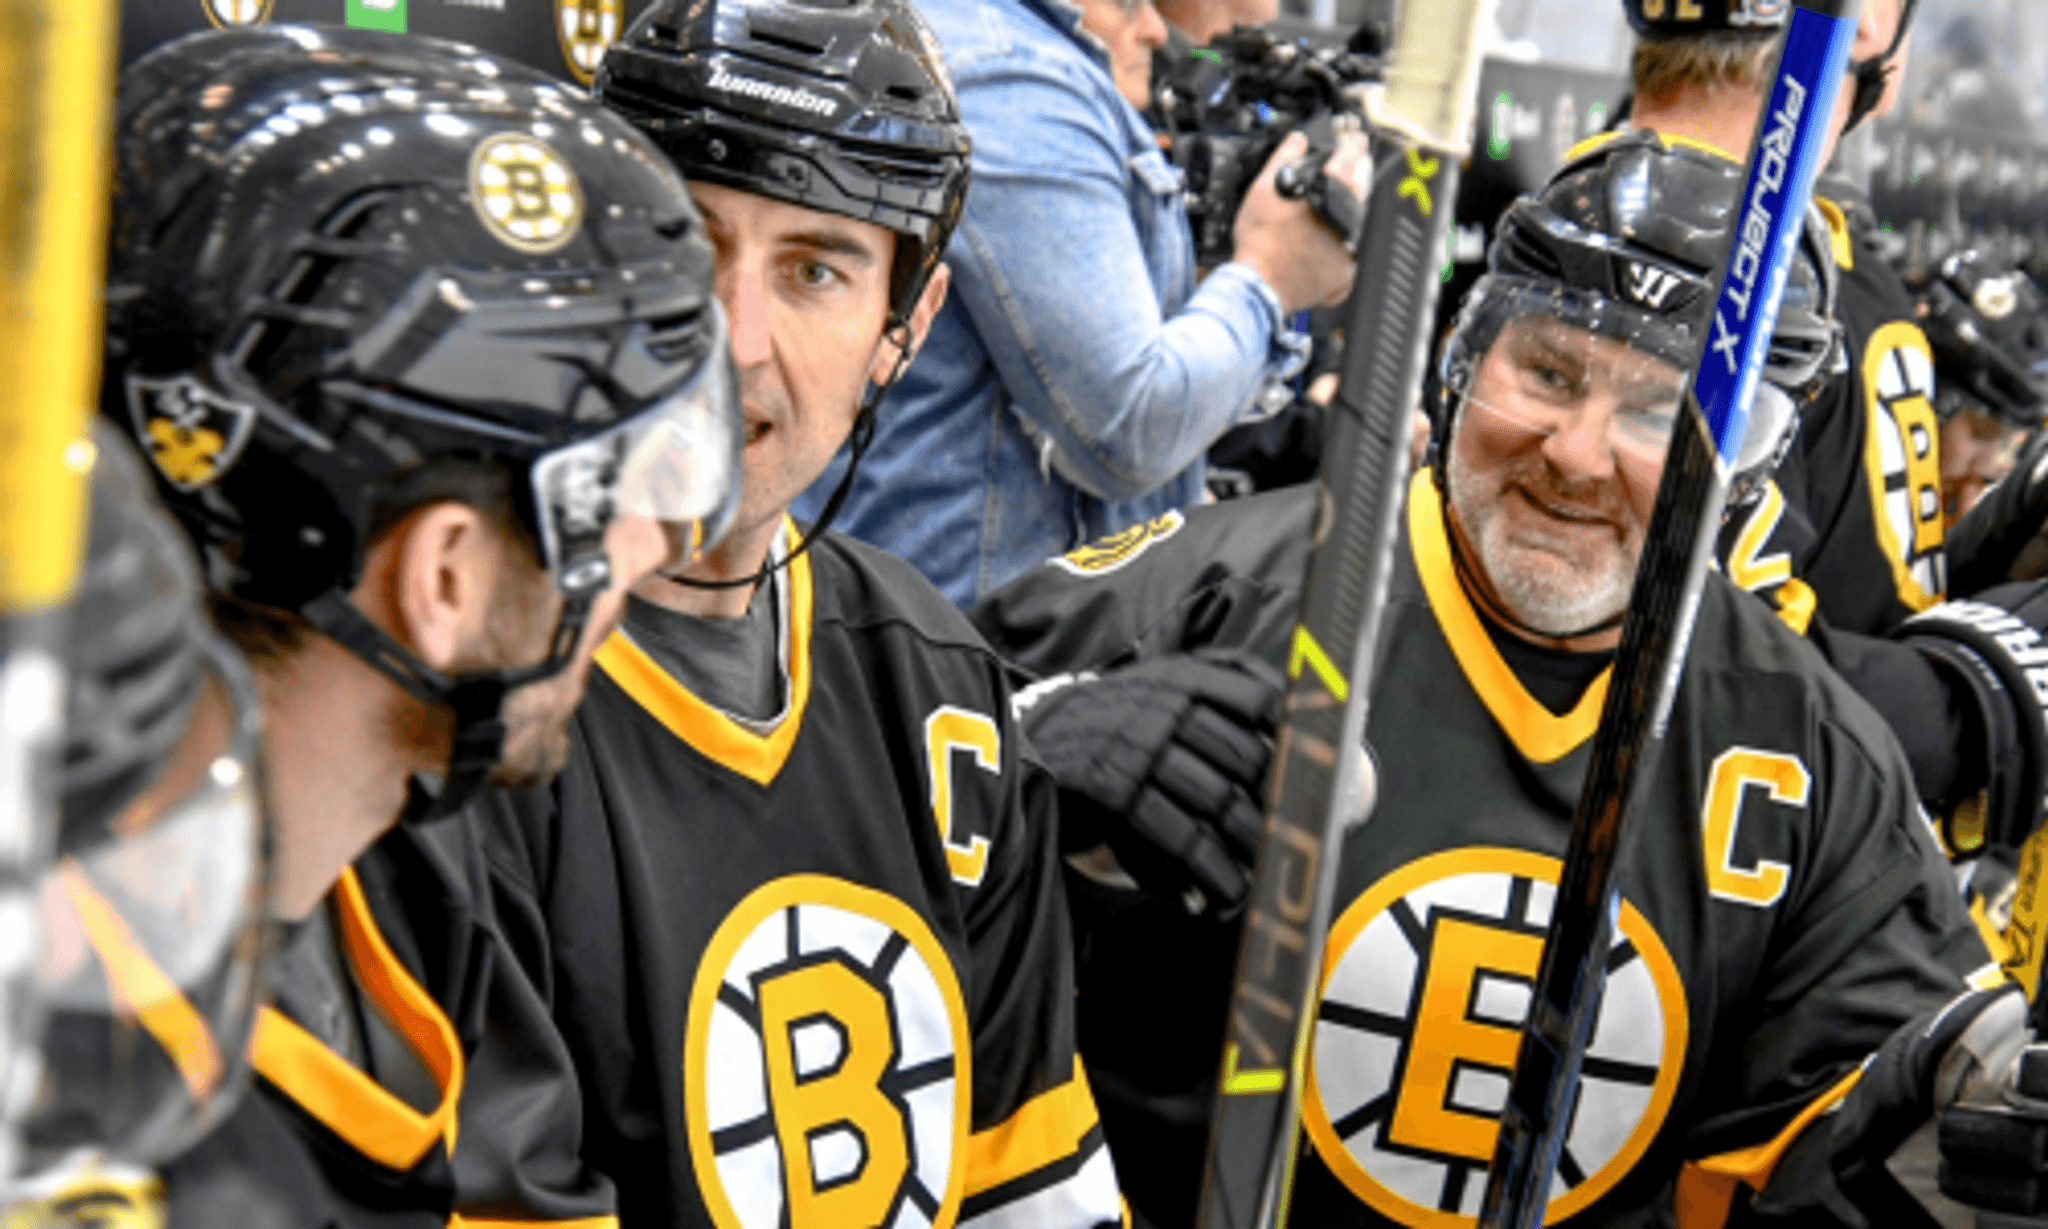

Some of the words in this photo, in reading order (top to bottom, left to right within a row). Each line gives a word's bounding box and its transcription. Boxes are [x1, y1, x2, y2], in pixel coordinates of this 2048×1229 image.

[1727, 73, 1806, 322] PROJECT
[1712, 308, 1740, 375] X
[924, 704, 1000, 888] C
[1702, 745, 1812, 907] C
[755, 953, 911, 1229] B
